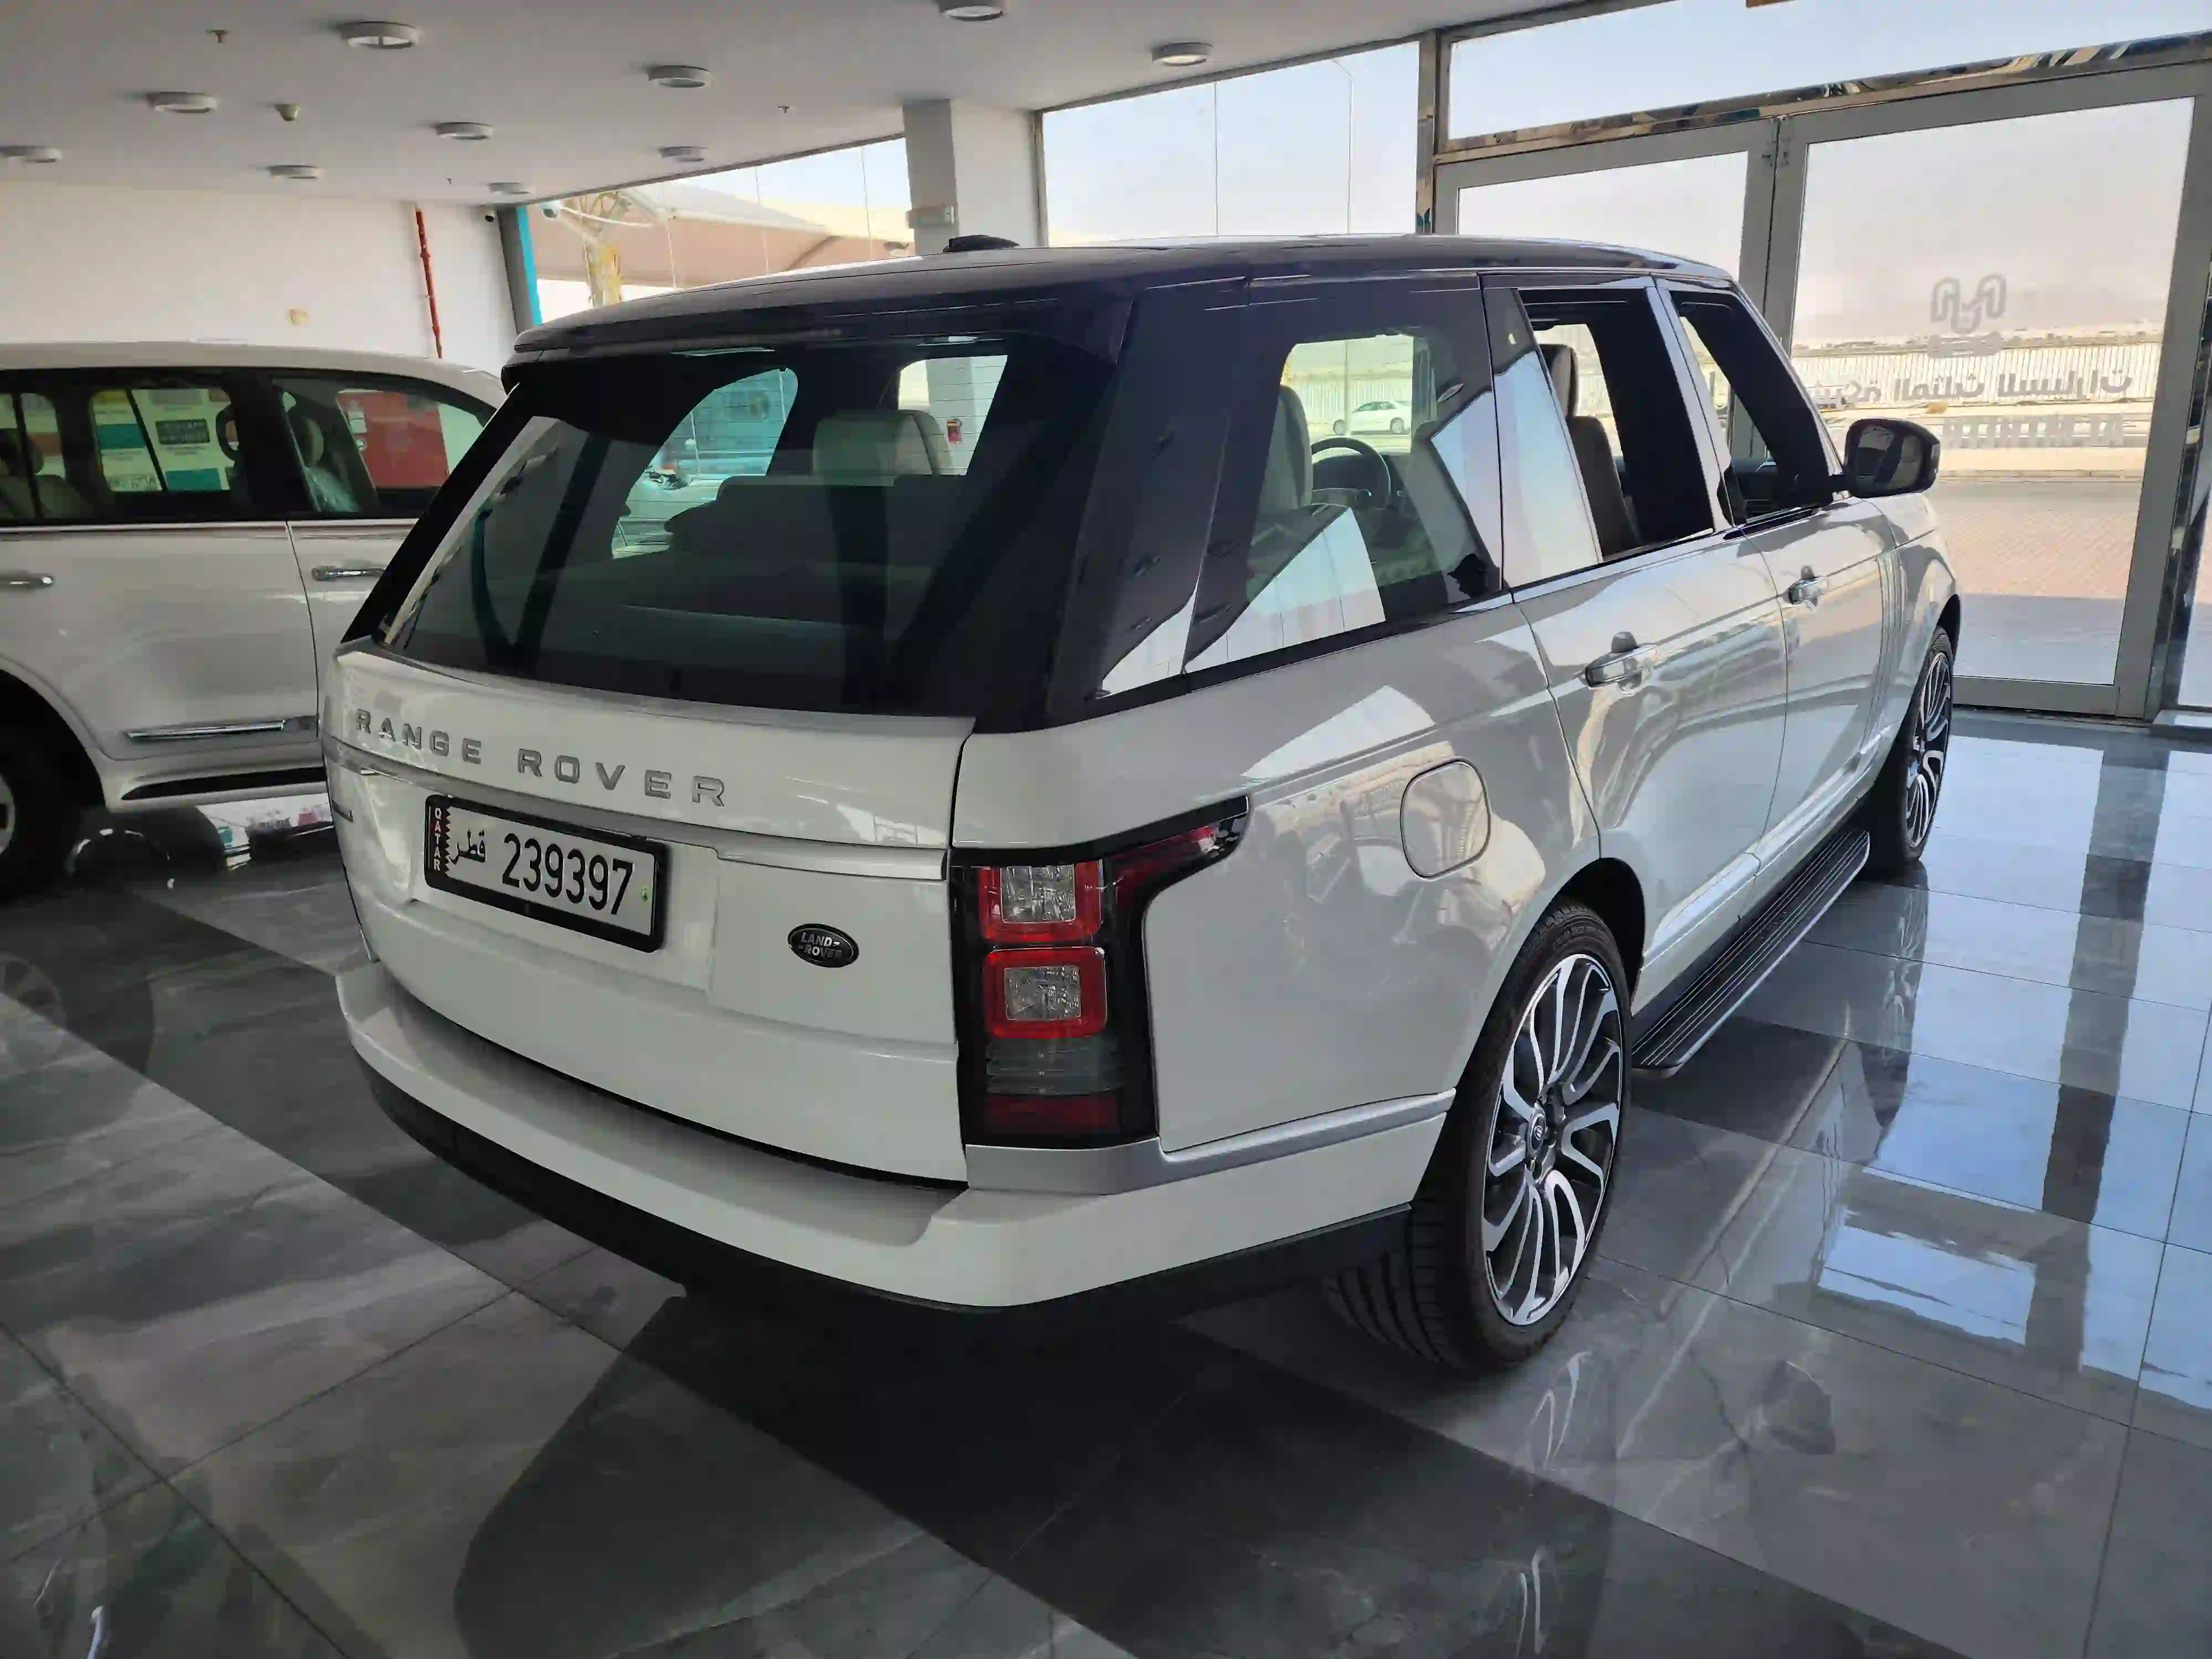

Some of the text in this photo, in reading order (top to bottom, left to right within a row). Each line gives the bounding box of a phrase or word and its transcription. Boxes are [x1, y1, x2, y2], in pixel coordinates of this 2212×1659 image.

[355, 708, 725, 808] RANGE ROVER
[433, 807, 443, 871] QATAR
[447, 828, 487, 865] قطر
[502, 833, 634, 915] 239397
[803, 944, 843, 959] ROVER
